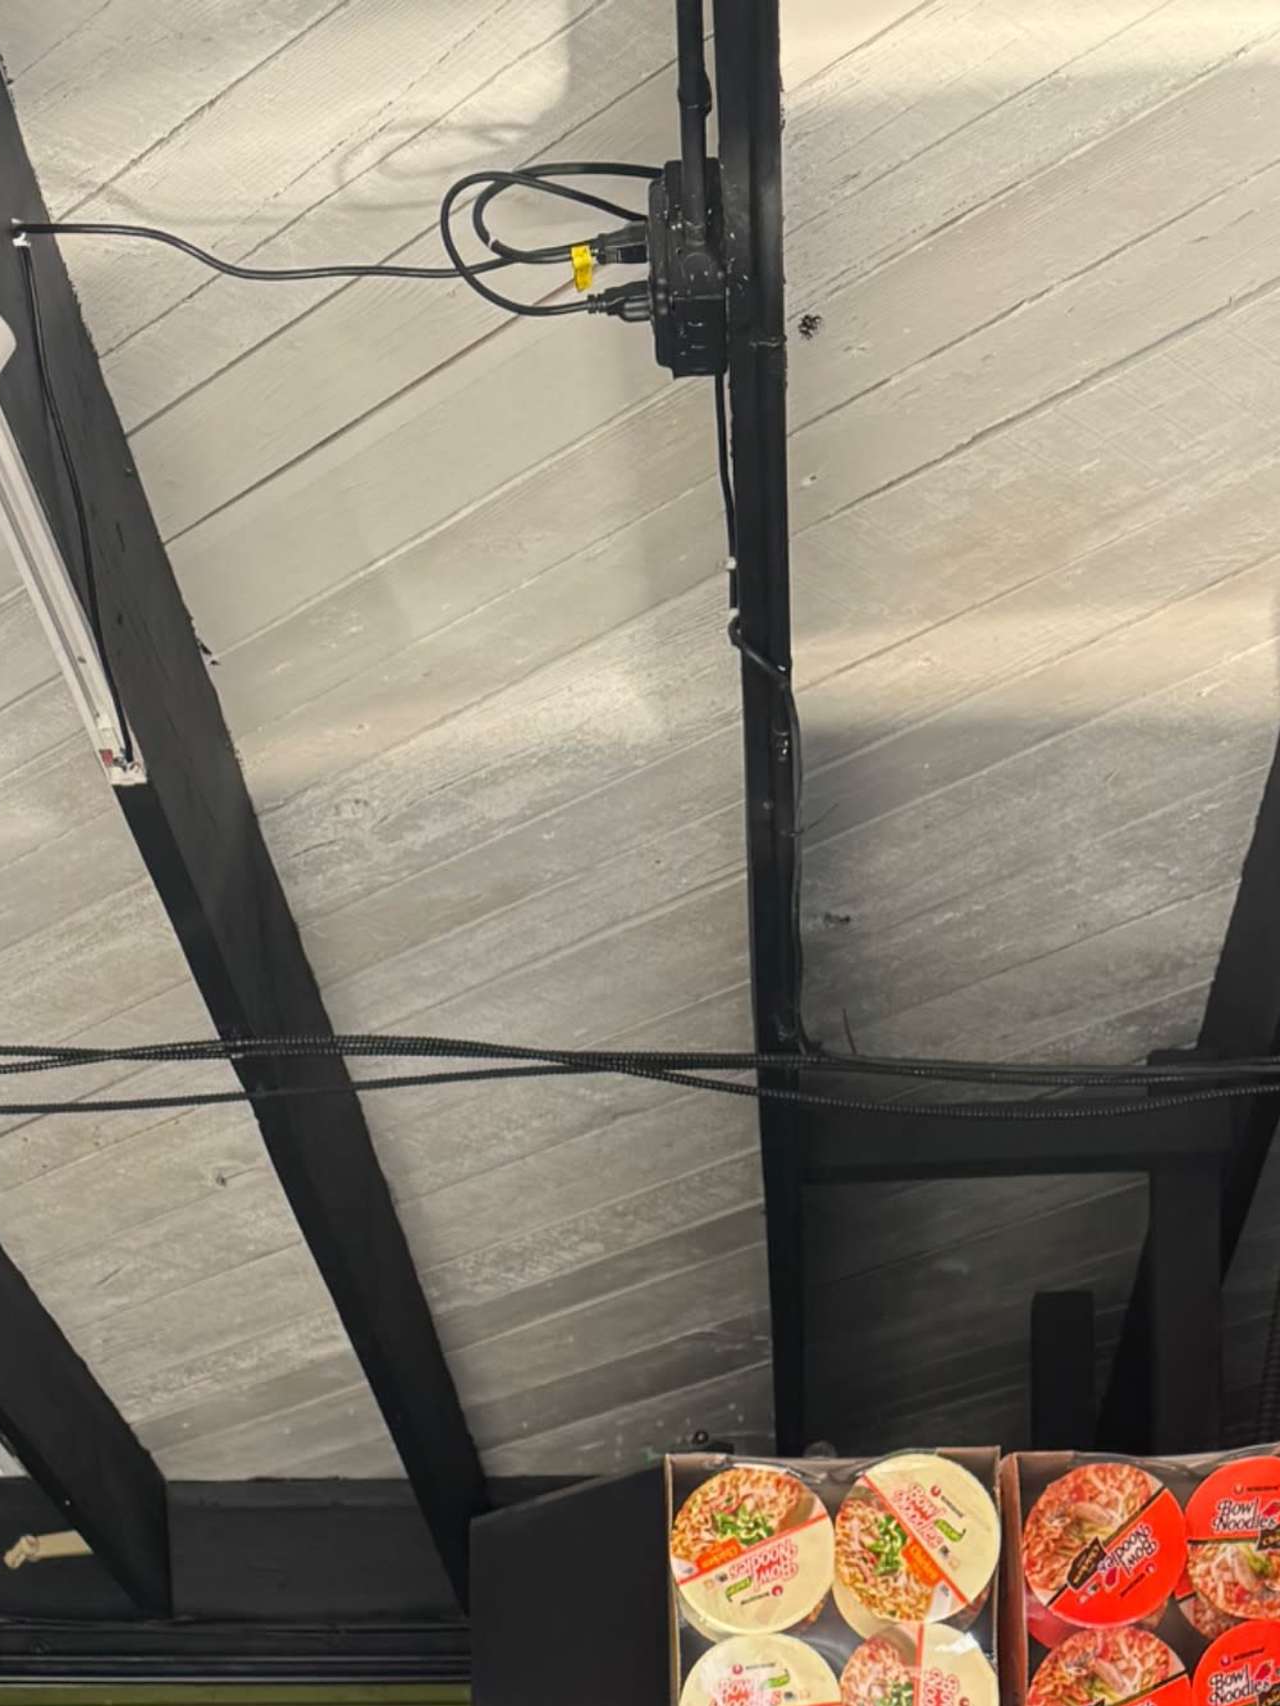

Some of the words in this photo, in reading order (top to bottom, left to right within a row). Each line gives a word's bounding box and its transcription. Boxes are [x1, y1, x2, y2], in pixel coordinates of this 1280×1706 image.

[1217, 1494, 1258, 1515] Bowl
[1212, 1516, 1276, 1533] Noodles
[1095, 1522, 1153, 1575] Noodles
[1118, 1536, 1161, 1577] Bowl
[1208, 1662, 1251, 1693] Bowl
